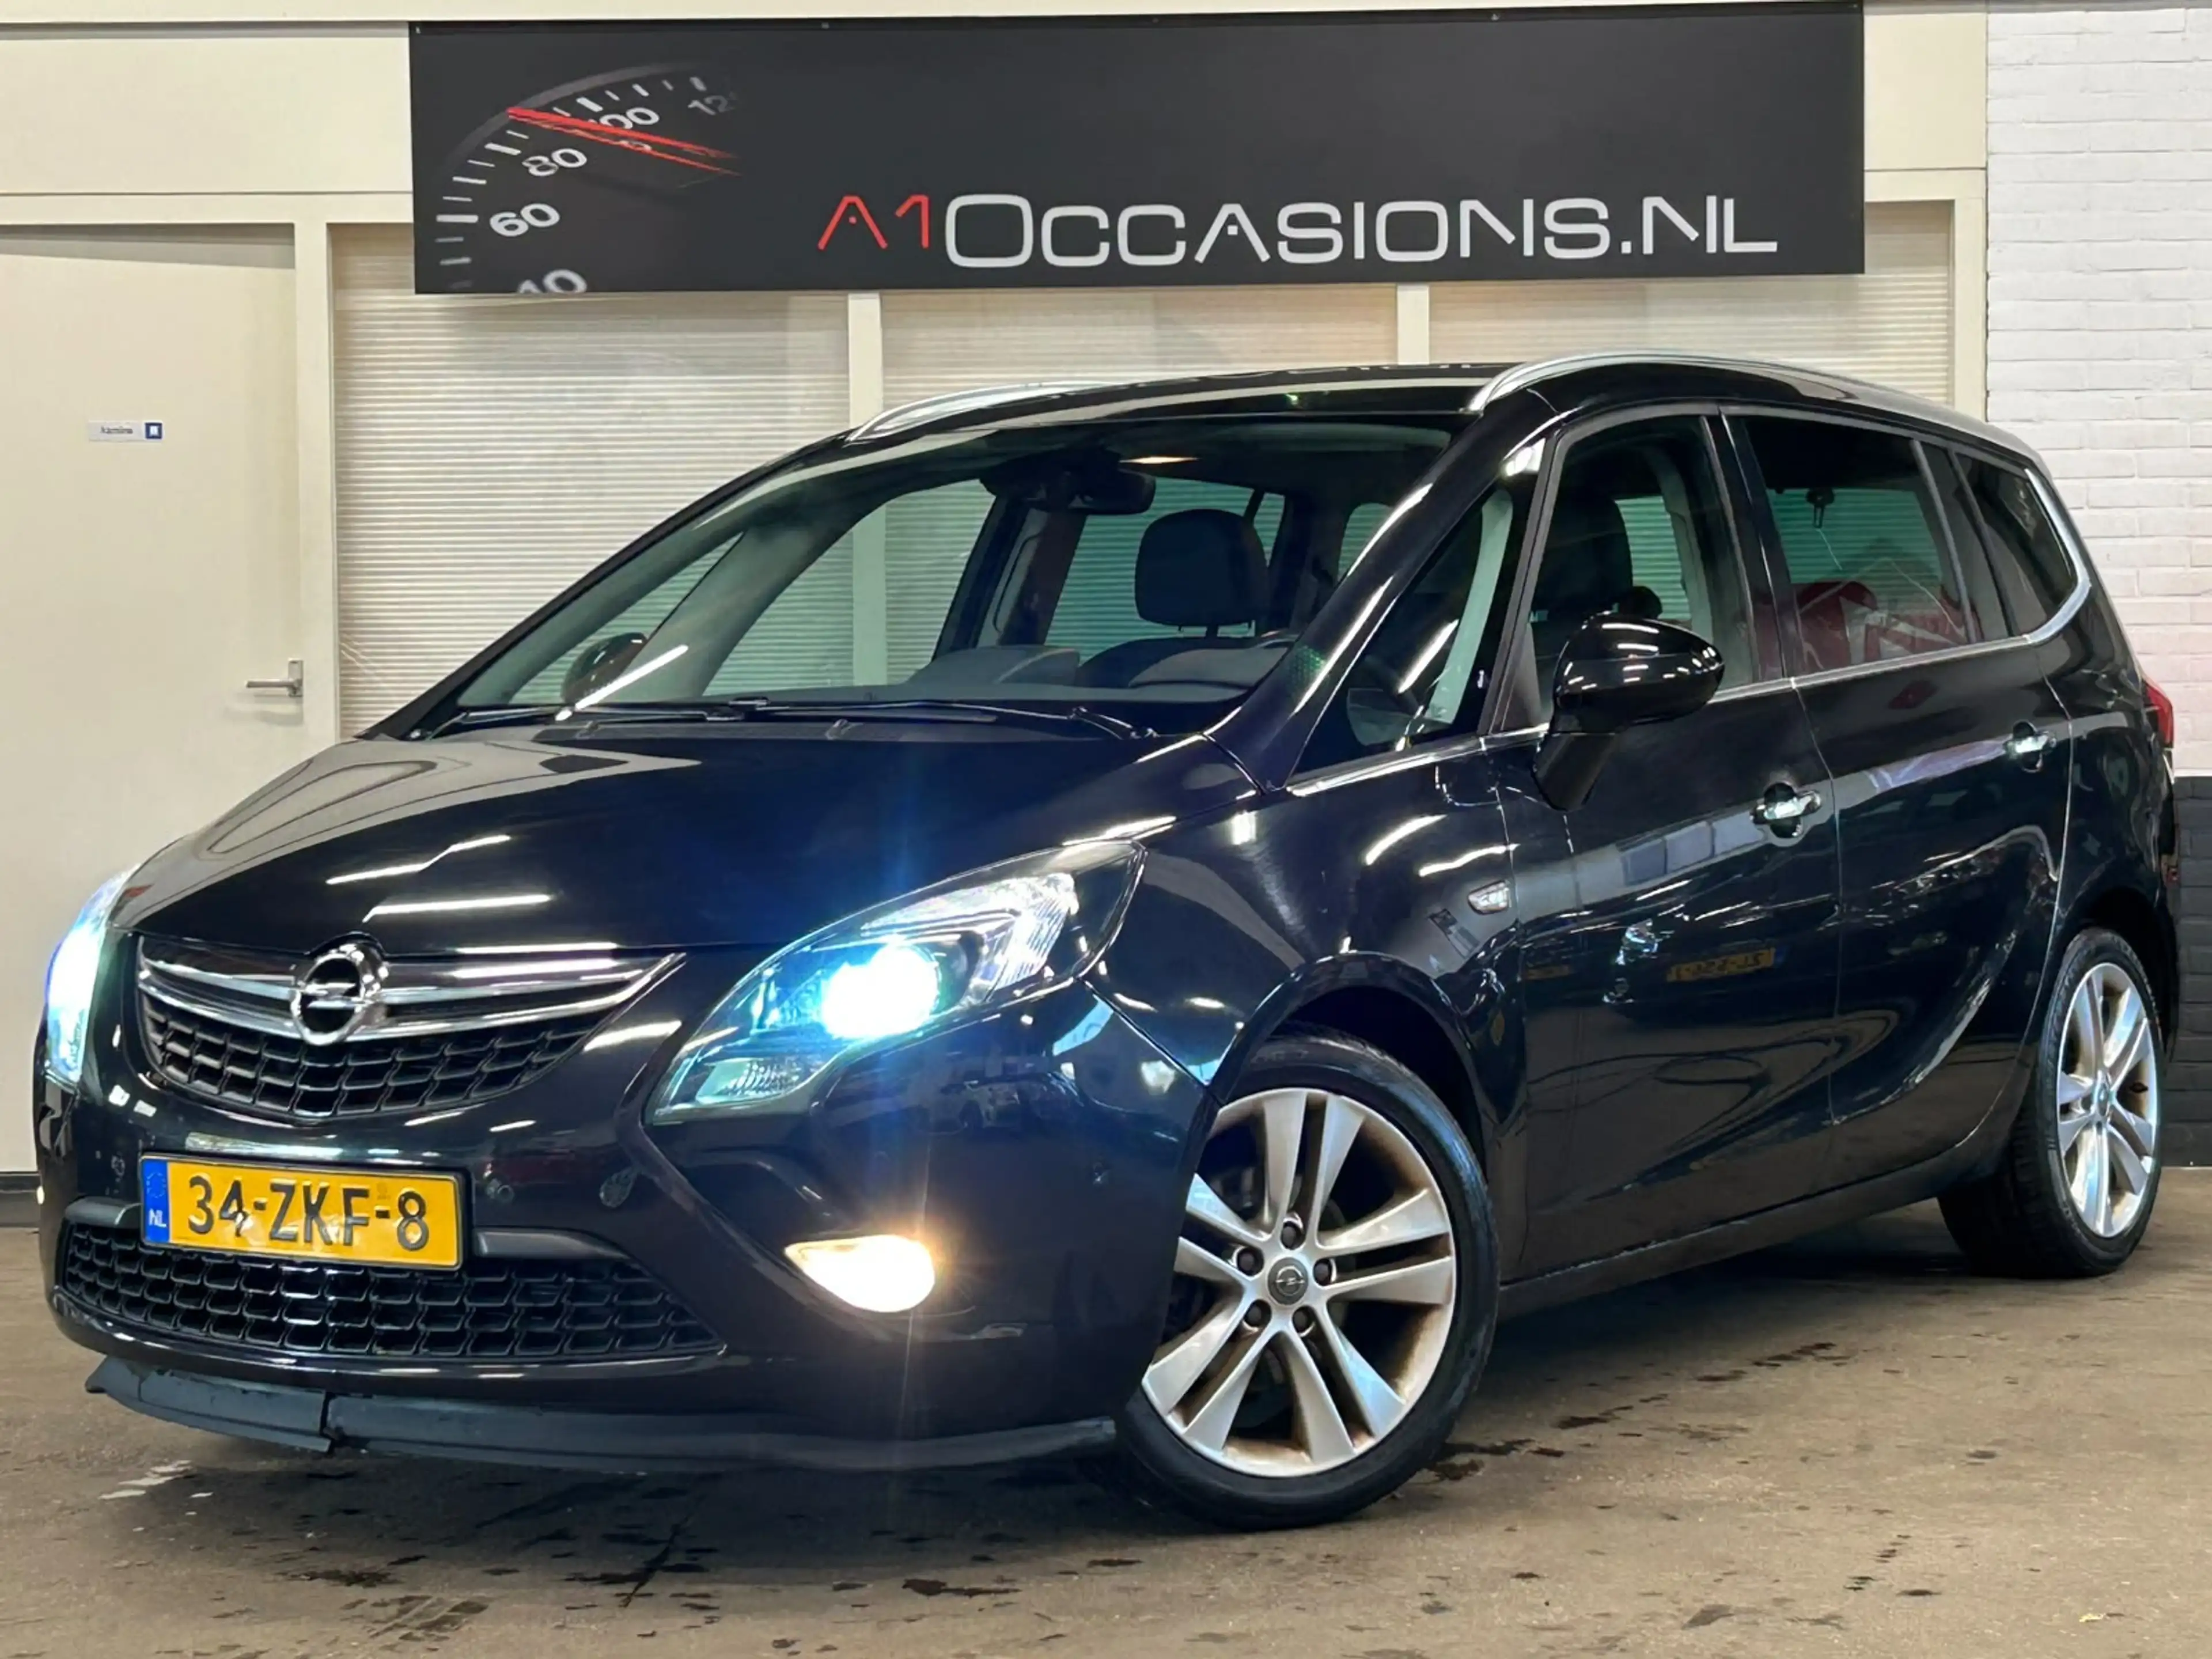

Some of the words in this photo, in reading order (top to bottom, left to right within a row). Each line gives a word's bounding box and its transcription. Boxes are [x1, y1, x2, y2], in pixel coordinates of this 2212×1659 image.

[522, 148, 587, 176] 80
[490, 203, 560, 237] 60
[149, 1209, 167, 1228] NL
[188, 1175, 430, 1252] 34-ZKF-8
